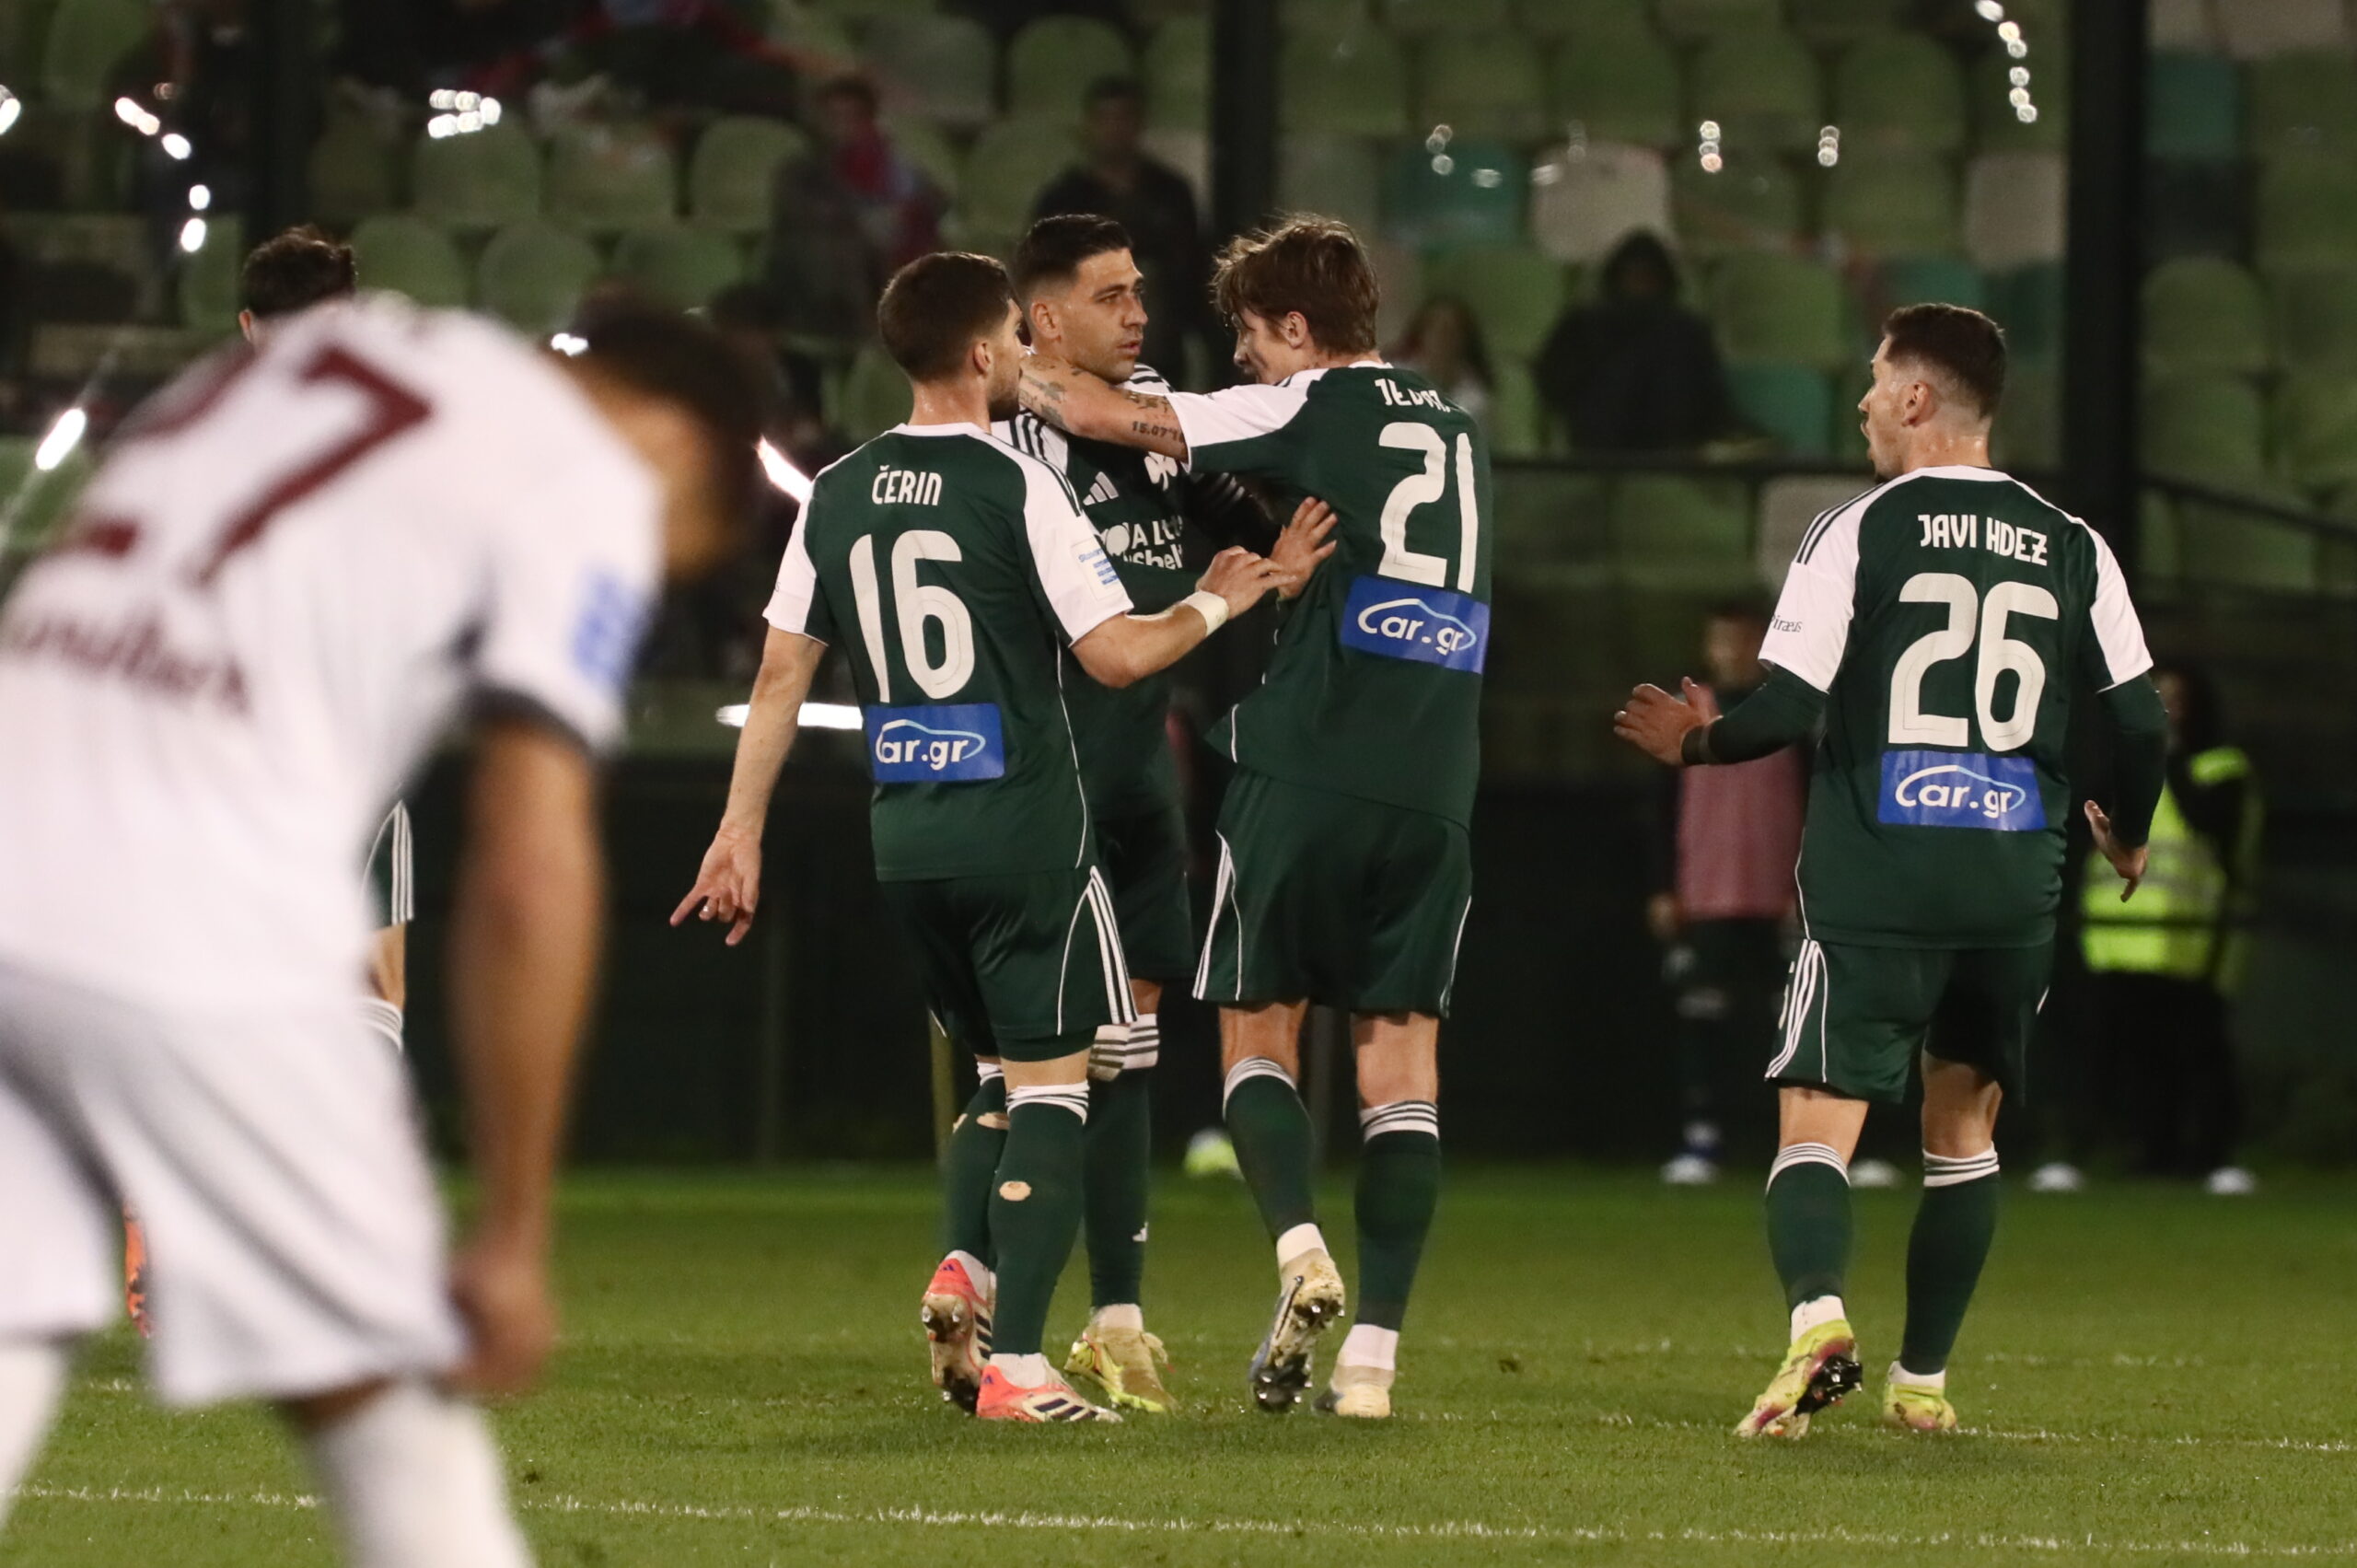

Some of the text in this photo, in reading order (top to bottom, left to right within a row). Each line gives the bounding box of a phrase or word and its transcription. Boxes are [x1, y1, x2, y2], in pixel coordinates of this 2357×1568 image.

[872, 465, 942, 505] ČERIN
[1377, 422, 1479, 593] 21
[1918, 514, 2048, 566] JAVI HDEZ
[849, 529, 975, 703] 16
[1888, 573, 2059, 752] 26
